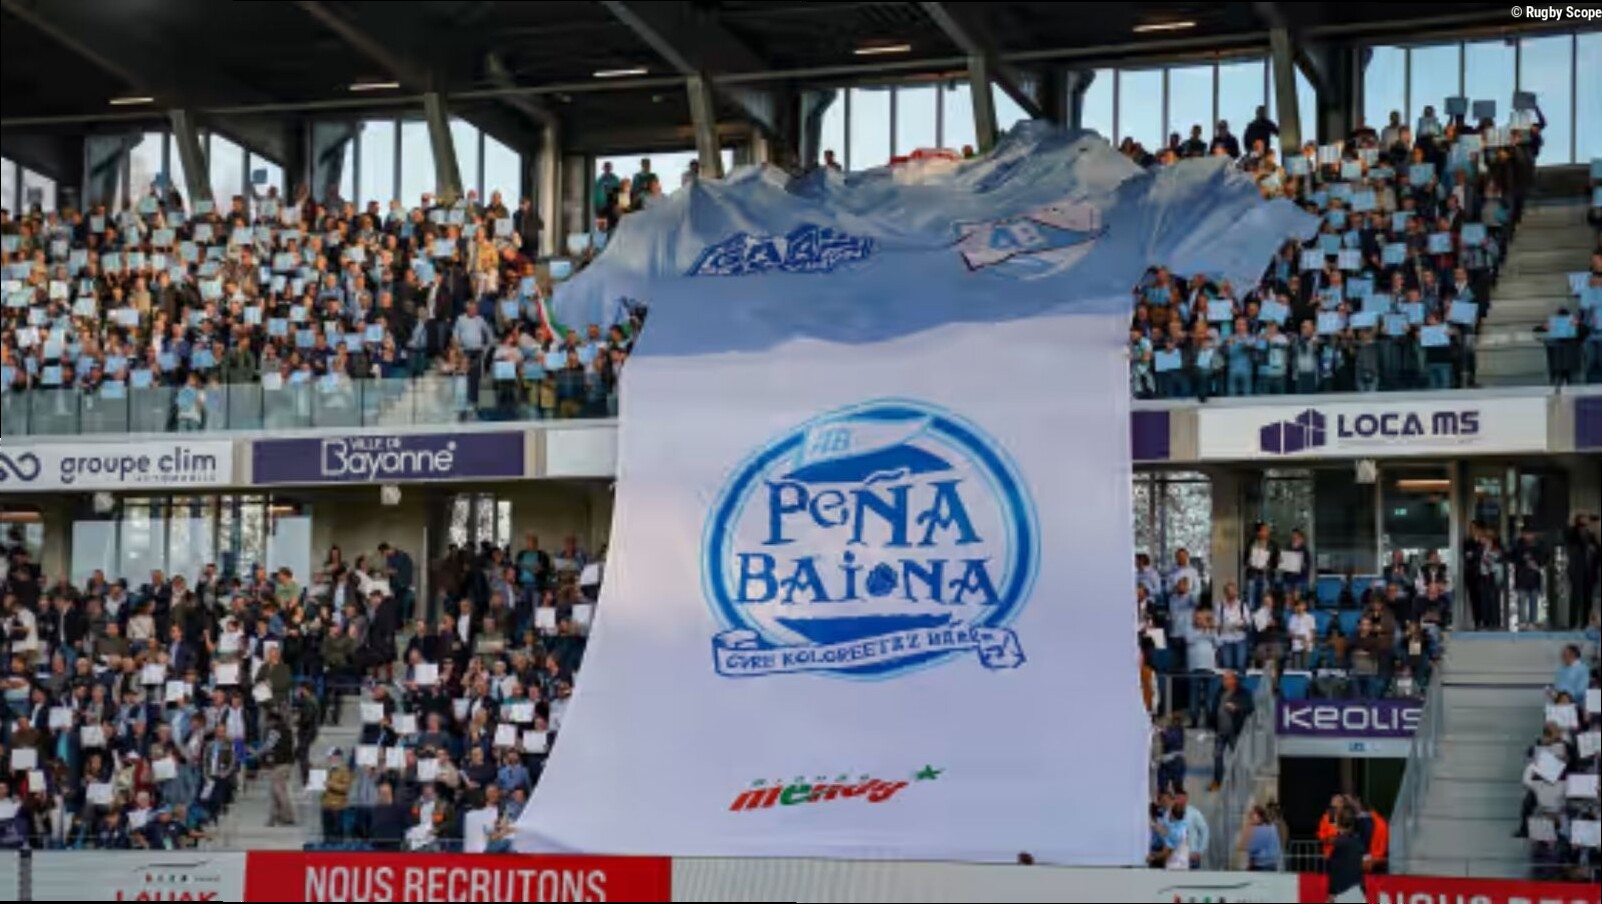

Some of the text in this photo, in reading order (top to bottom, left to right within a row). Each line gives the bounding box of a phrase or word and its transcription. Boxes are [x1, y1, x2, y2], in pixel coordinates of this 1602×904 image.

[1338, 412, 1424, 439] LOCA
[60, 446, 217, 484] groupe clim
[321, 438, 454, 481] Bayonne
[305, 866, 607, 903] NOUS RECRUTONS
